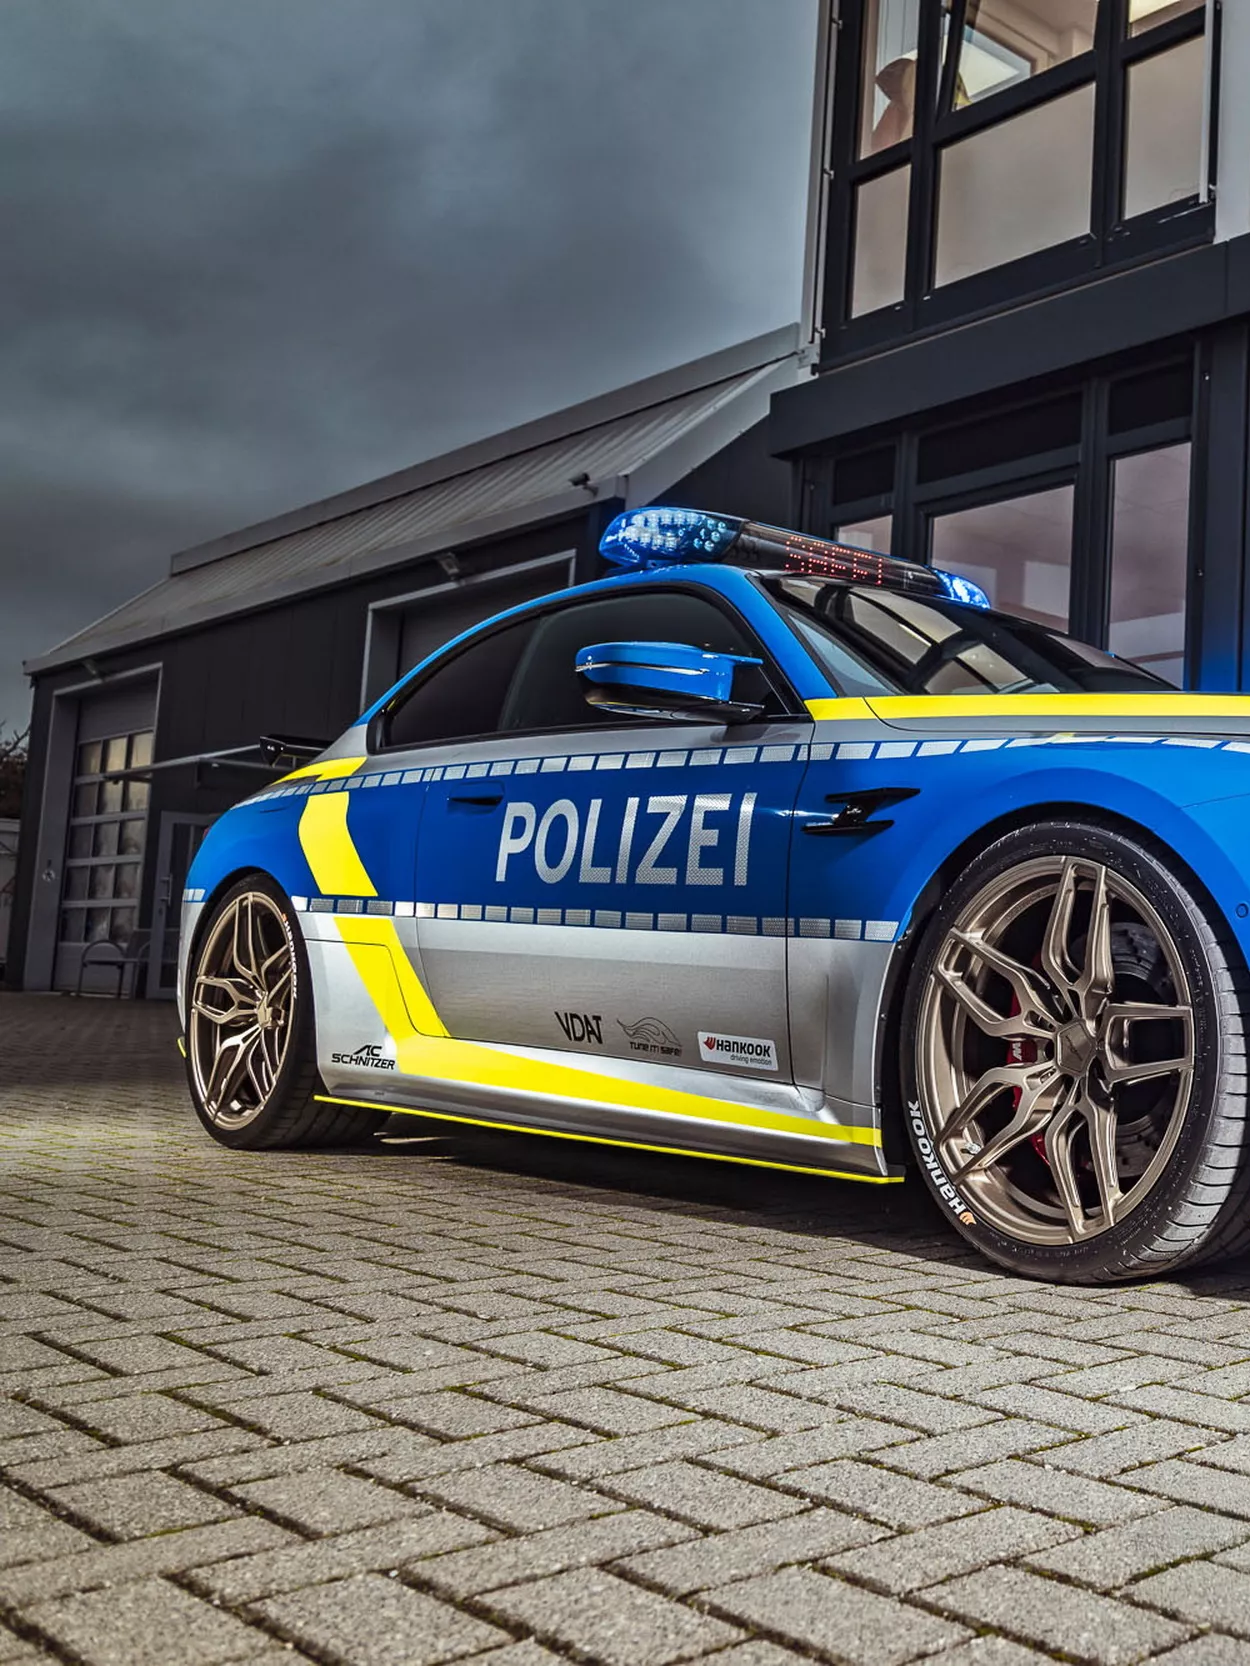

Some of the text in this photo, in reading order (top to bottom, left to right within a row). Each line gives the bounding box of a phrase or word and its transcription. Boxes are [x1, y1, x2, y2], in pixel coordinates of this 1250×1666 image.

[495, 792, 758, 886] POLIZEI
[554, 1011, 604, 1045] VDAT
[353, 1044, 383, 1057] AC
[730, 1053, 749, 1064] driving
[331, 1053, 396, 1070] SCHNITZER
